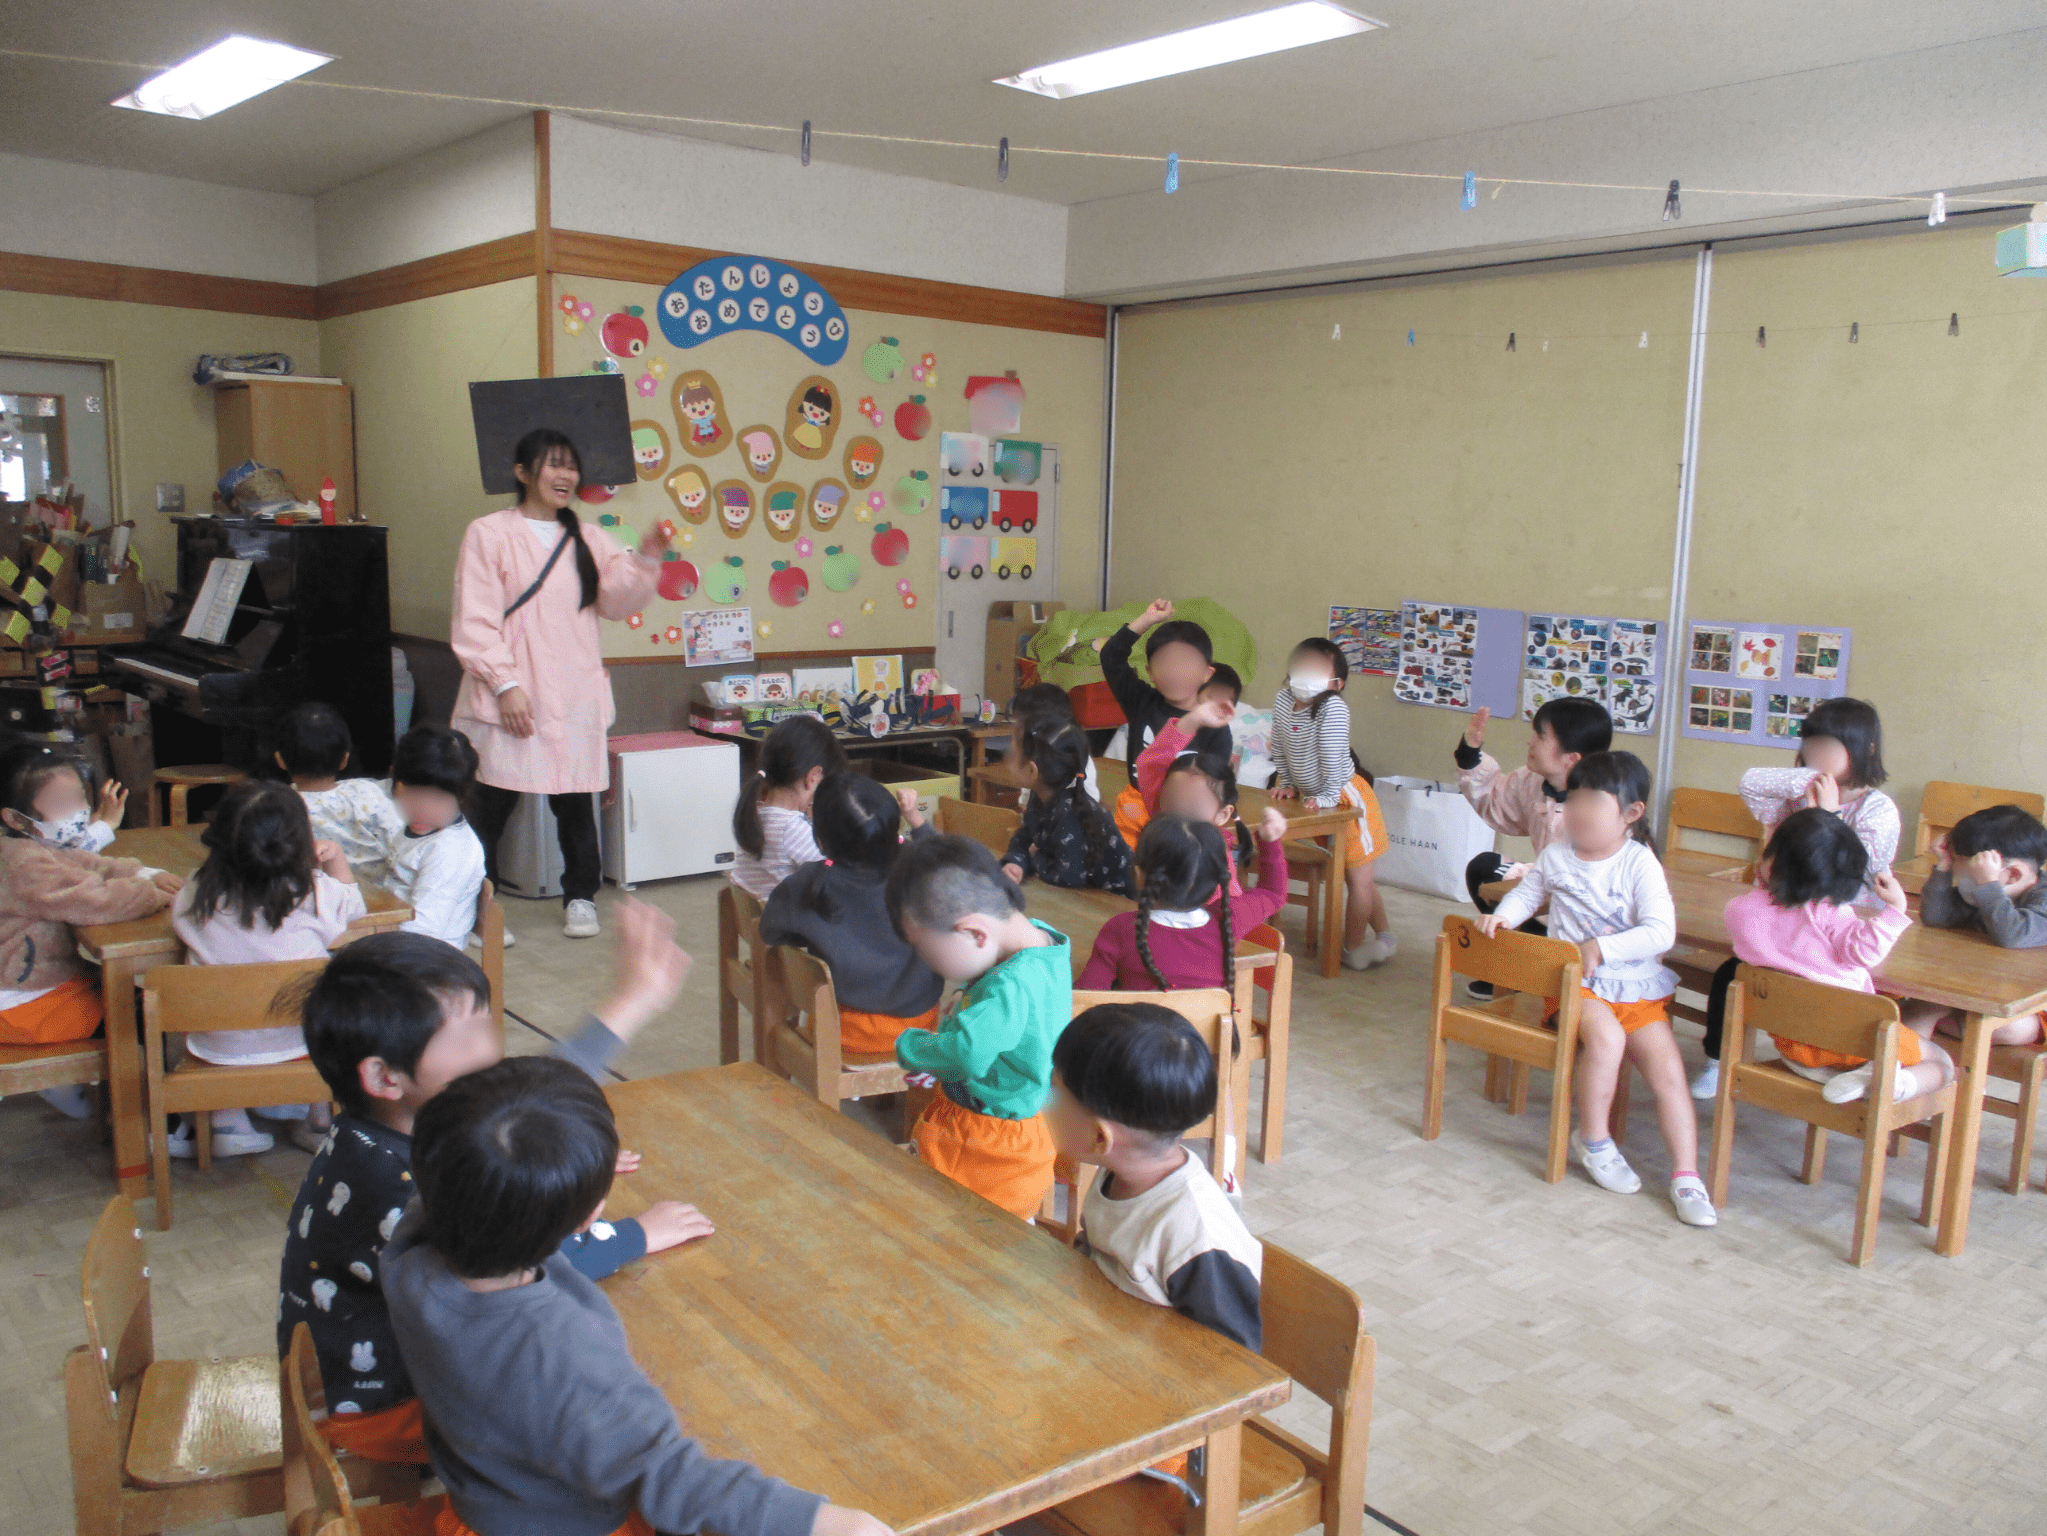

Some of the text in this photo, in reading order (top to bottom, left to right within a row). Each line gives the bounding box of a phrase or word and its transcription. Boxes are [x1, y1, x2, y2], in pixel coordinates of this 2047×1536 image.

[670, 269, 842, 336] おたんじょうび
[694, 303, 816, 343] おめでとう
[1410, 839, 1438, 850] HAAN
[1457, 923, 1471, 949] 3
